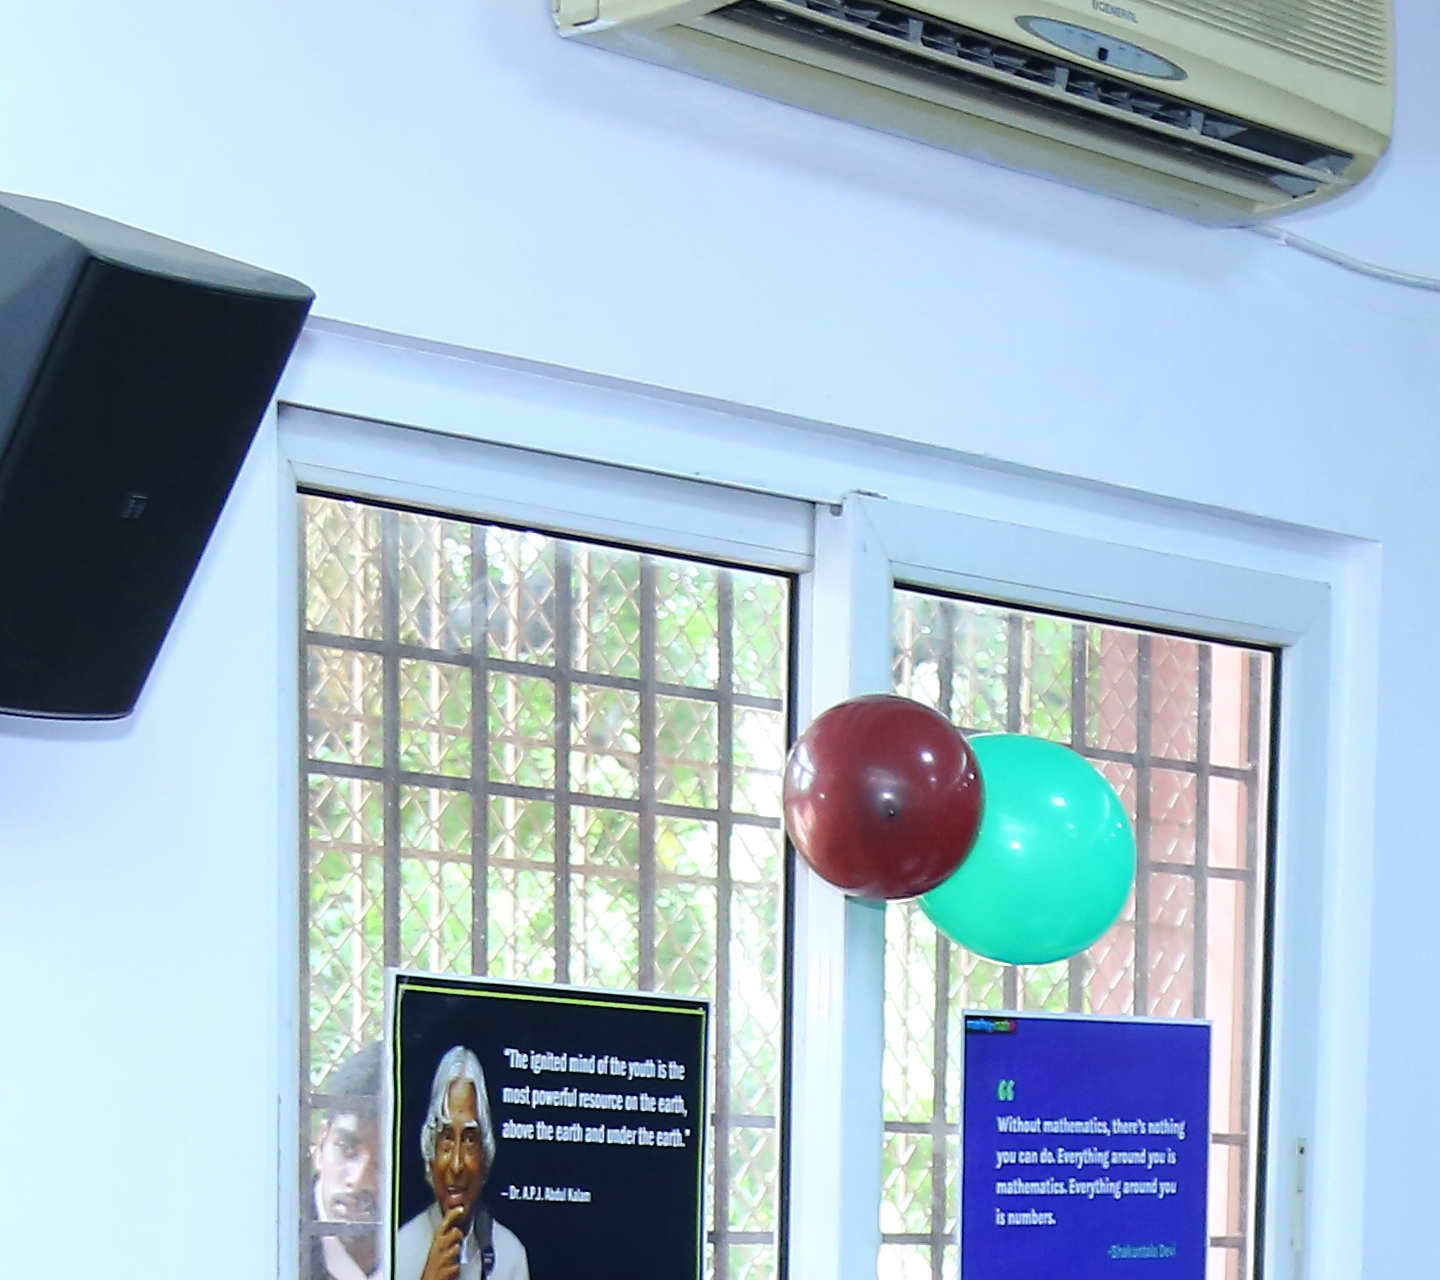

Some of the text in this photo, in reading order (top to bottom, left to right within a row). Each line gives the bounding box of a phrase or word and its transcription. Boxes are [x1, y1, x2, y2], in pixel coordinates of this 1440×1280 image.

[530, 1051, 567, 1074] ignited
[568, 1053, 595, 1074] mind
[597, 1055, 609, 1075] of
[609, 1056, 628, 1076] the
[628, 1059, 656, 1081] youth
[657, 1060, 667, 1078] is
[668, 1060, 685, 1080] the
[503, 1086, 687, 1117] most powerful resource on the earth,
[502, 1120, 534, 1140] above
[536, 1121, 554, 1141] the
[556, 1123, 583, 1142] earth
[584, 1124, 606, 1143] and
[607, 1125, 636, 1145] under
[638, 1127, 655, 1146] the
[996, 1116, 1041, 1134] Without
[1043, 1117, 1110, 1136] mathematics,
[1148, 1118, 1186, 1139] nothing
[996, 1148, 1176, 1168] you can do. Everything around you is
[996, 1177, 1177, 1199] mathematics. Everything around you
[996, 1208, 1056, 1226] is numbers.
